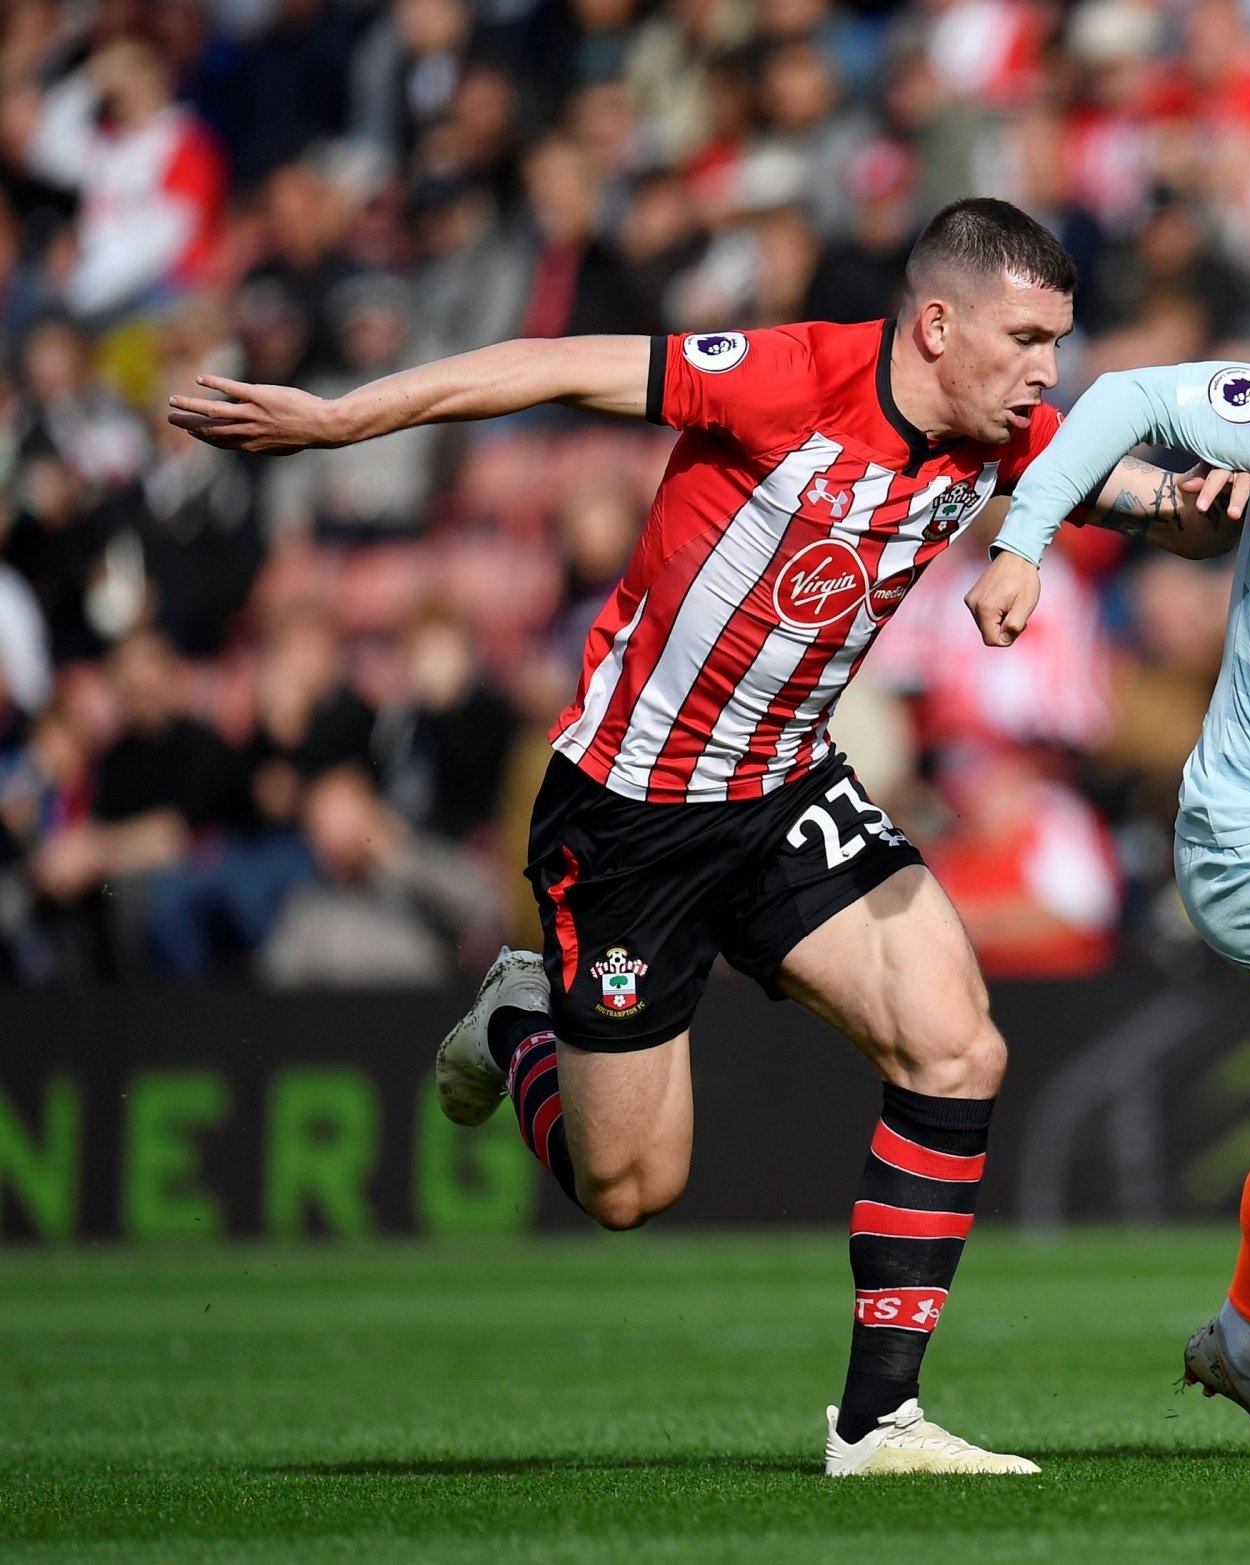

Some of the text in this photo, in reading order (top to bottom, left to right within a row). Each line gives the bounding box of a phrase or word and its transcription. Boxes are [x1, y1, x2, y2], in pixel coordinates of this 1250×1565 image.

[790, 556, 857, 615] Virgin
[786, 777, 895, 870] 23
[595, 1003, 638, 1018] SOUTHAMPTON
